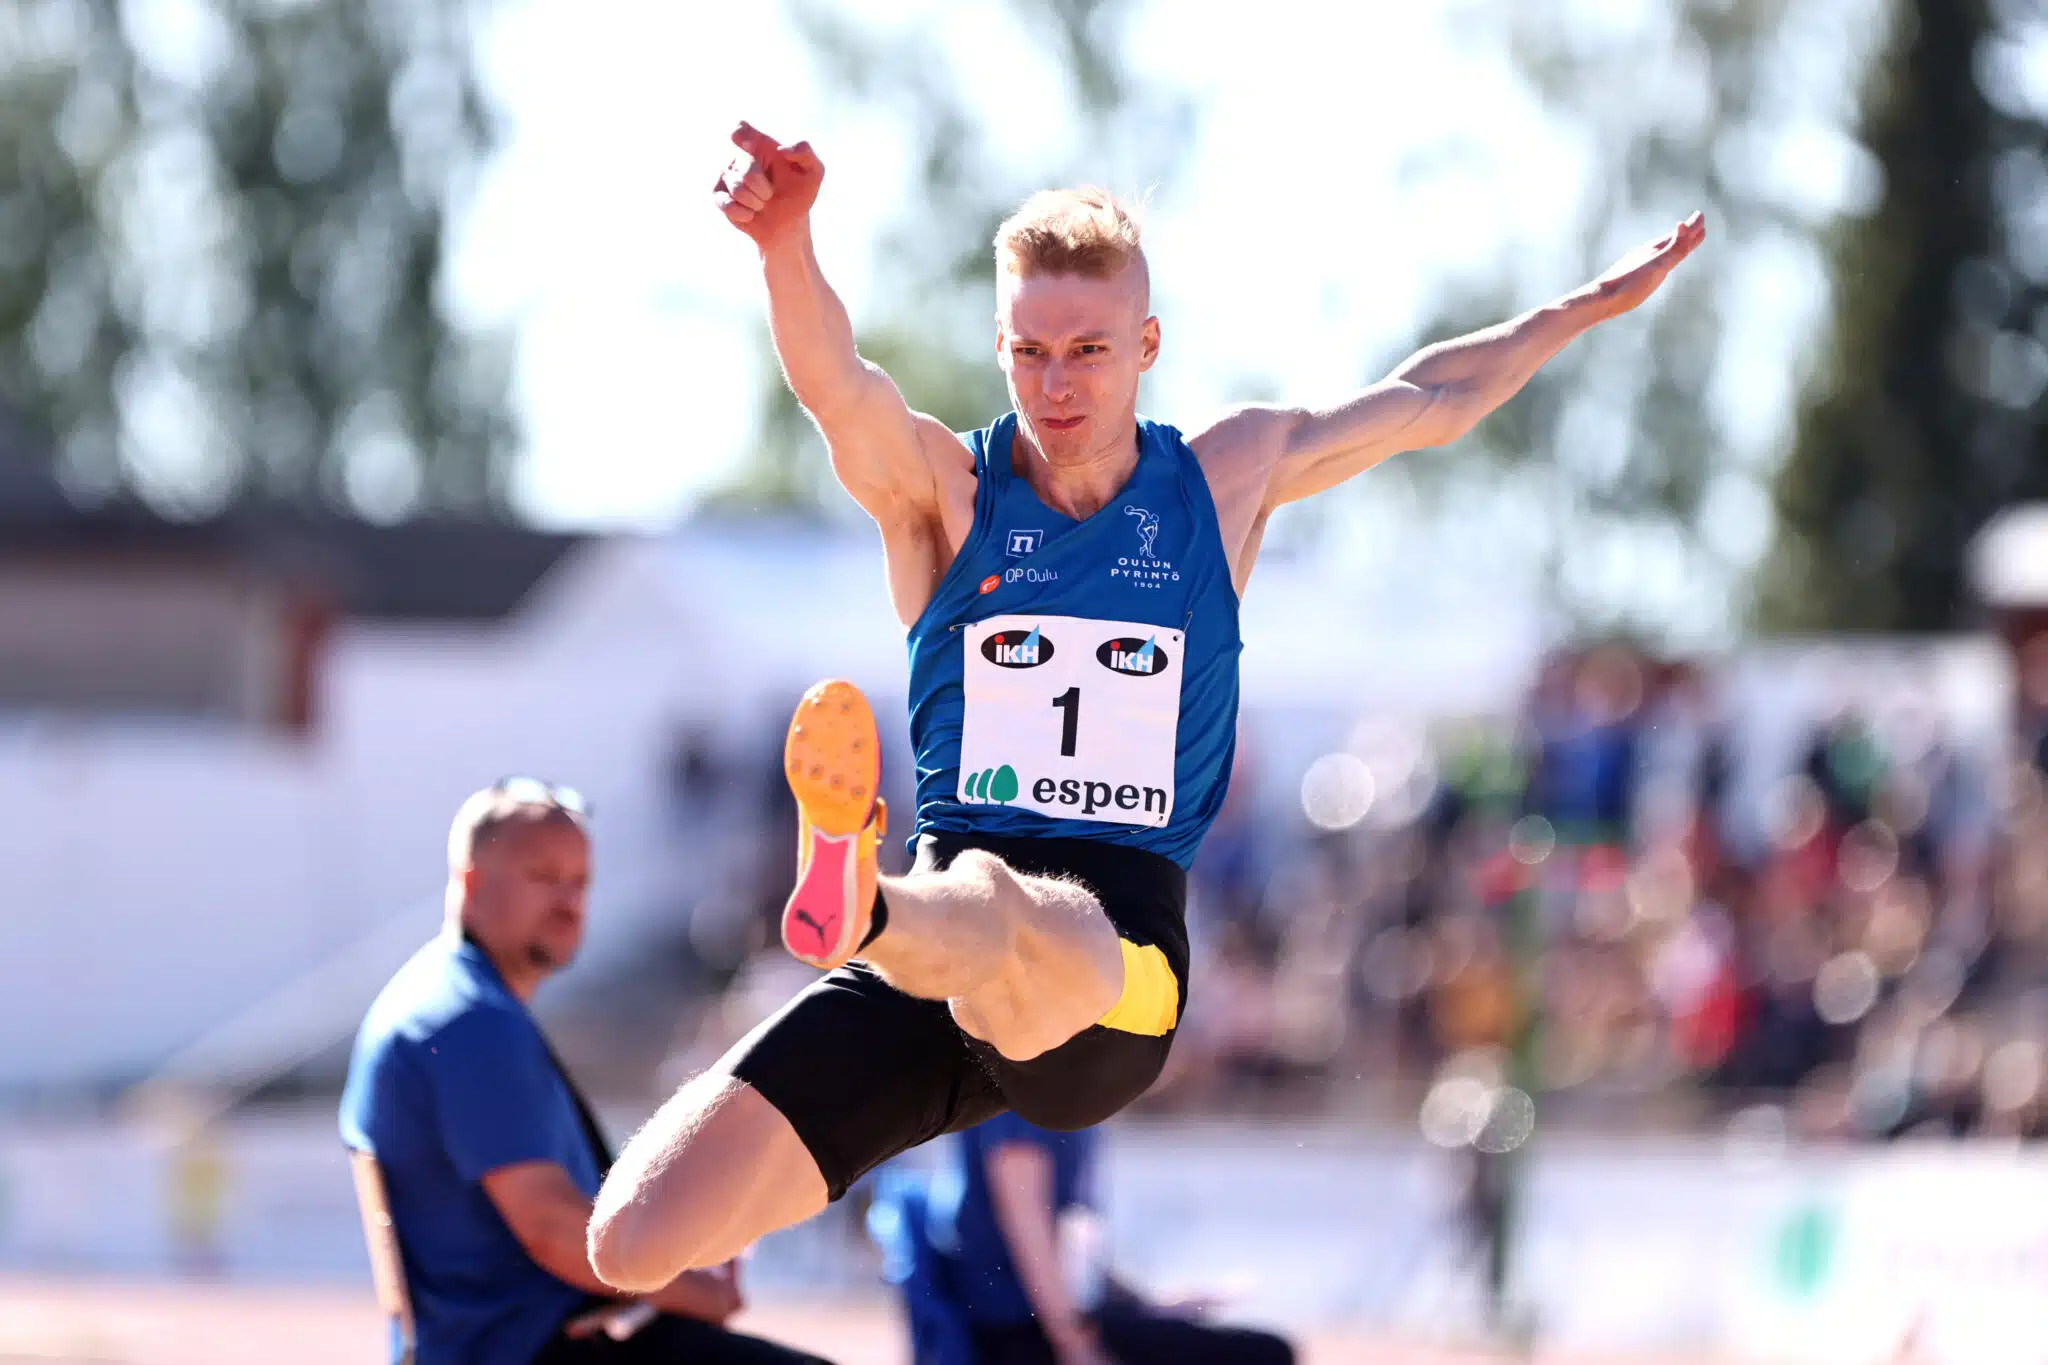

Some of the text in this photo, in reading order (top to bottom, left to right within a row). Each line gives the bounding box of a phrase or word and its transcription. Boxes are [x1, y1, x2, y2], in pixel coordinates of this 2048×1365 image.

[1118, 557, 1171, 569] OULUN
[1005, 568, 1058, 583] OP Oulu
[1111, 568, 1180, 581] PYRINTÖ
[1052, 686, 1080, 757] 1
[1032, 776, 1167, 815] espen
